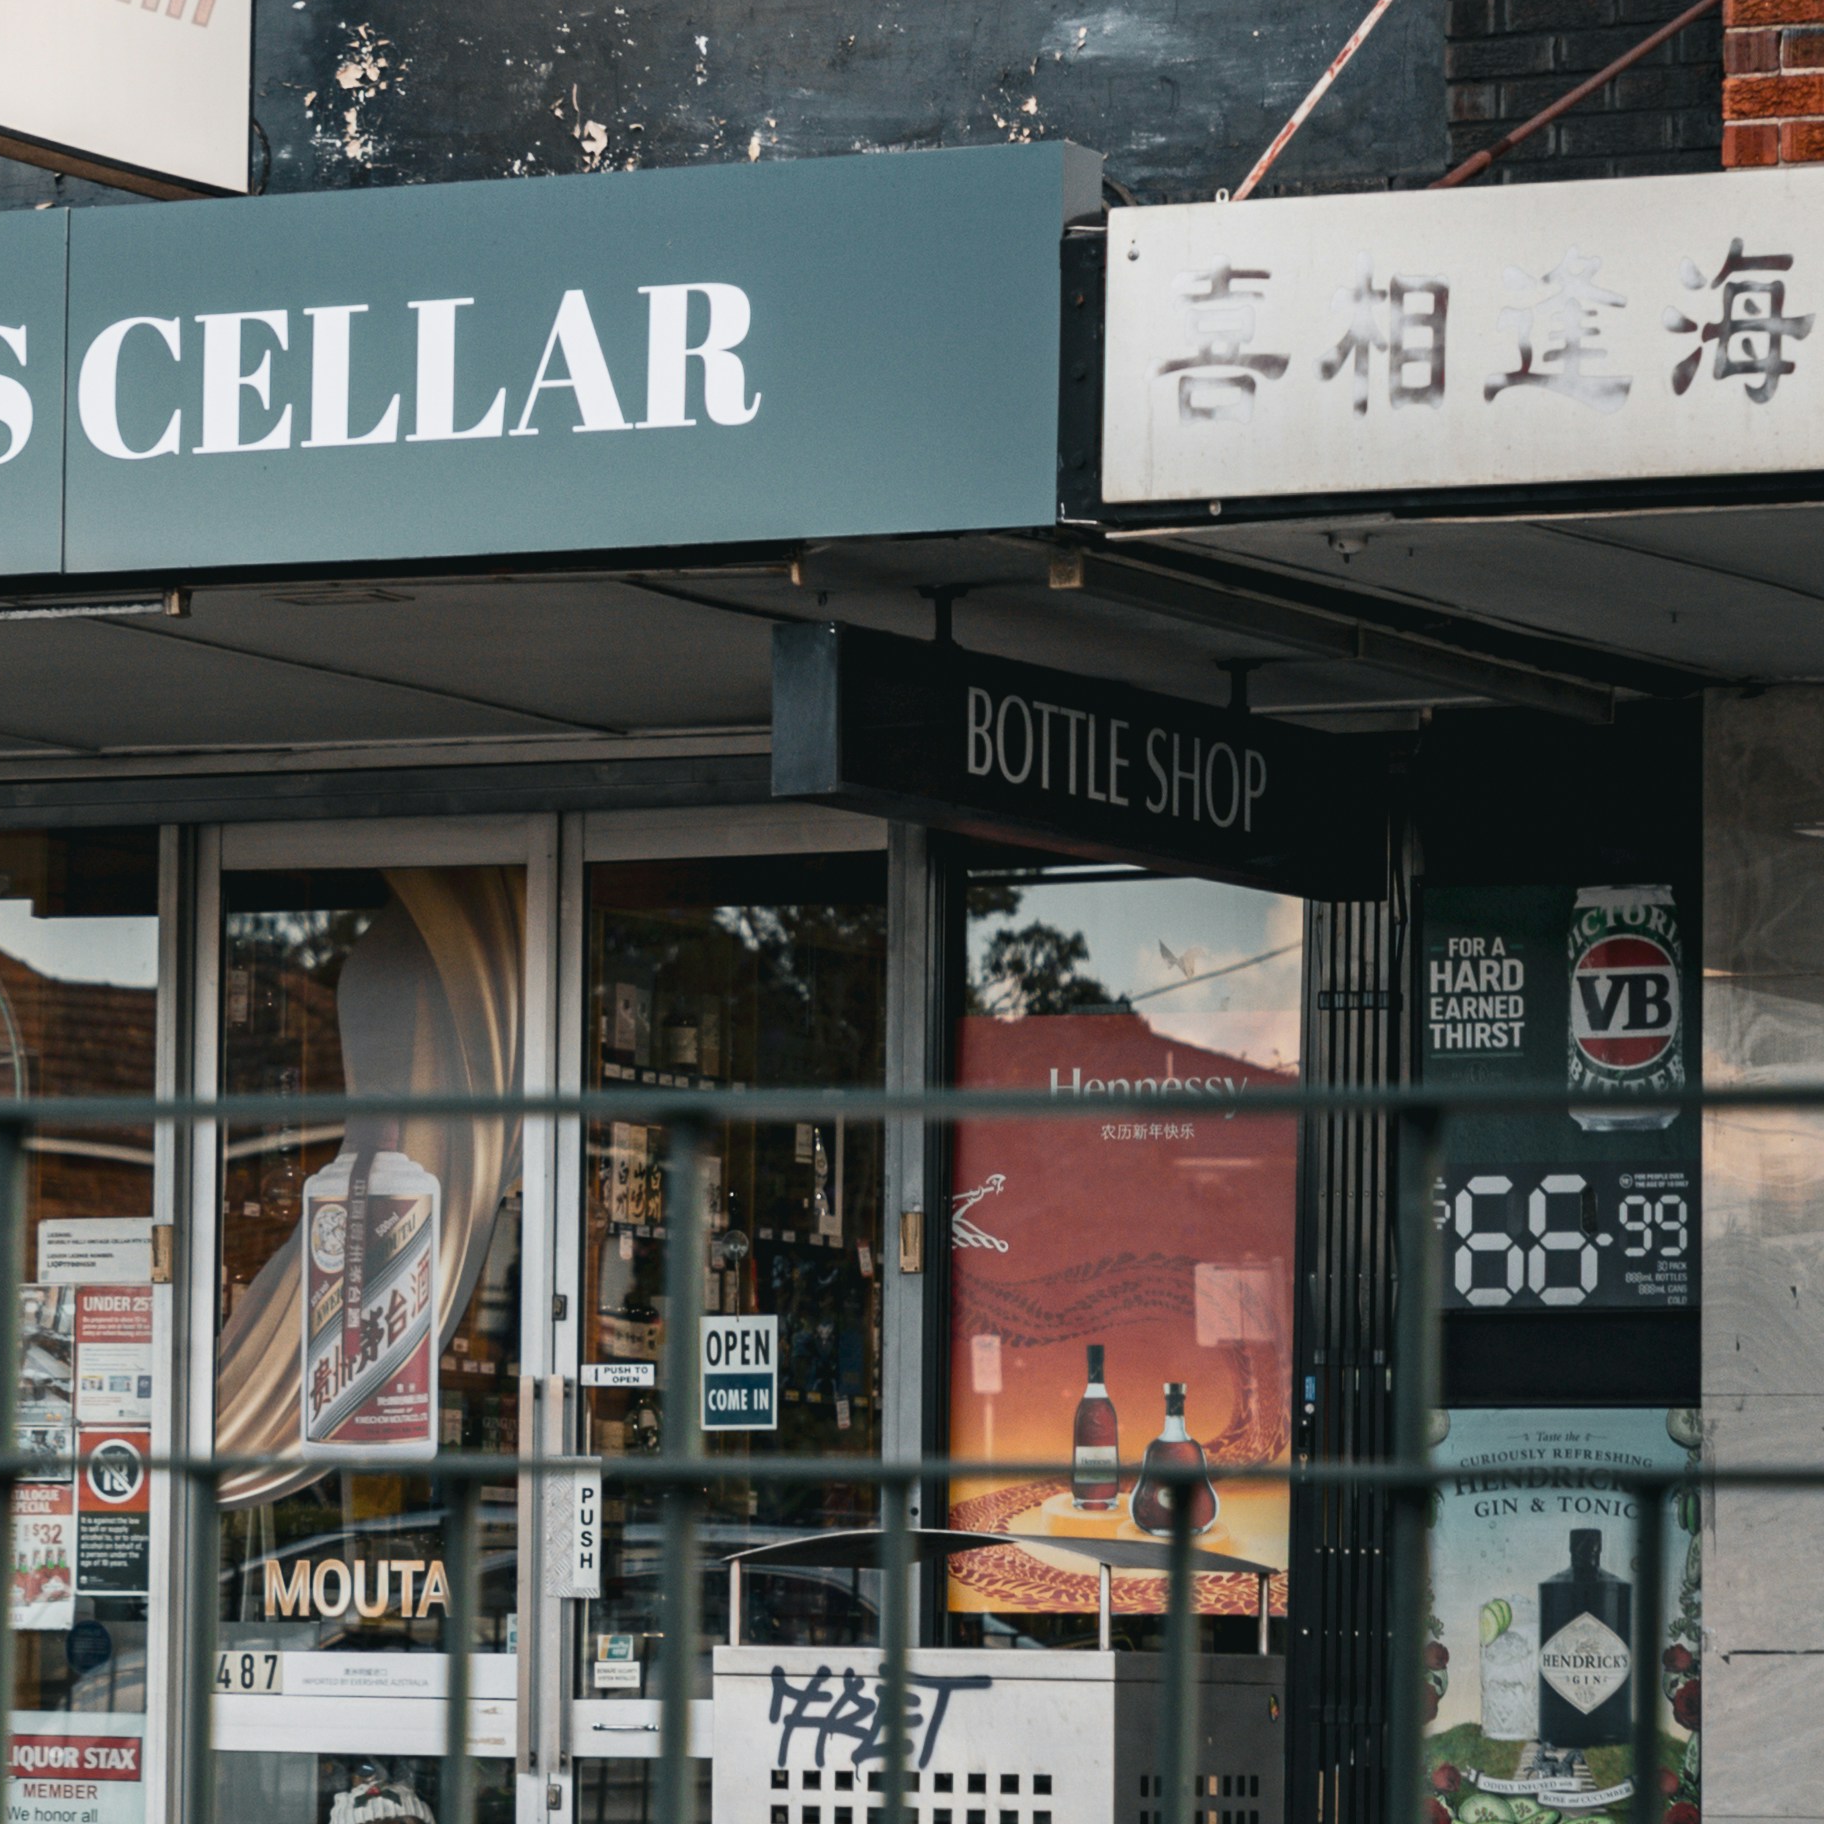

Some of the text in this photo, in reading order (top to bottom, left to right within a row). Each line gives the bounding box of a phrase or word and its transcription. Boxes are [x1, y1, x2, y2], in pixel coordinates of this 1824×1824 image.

[78, 282, 762, 460] CELLAR
[967, 686, 1267, 832] BOTTLE SHOP
[1449, 936, 1507, 958] FOR A
[1430, 958, 1525, 994] HARD
[1430, 994, 1525, 1021] EARNED
[1577, 973, 1673, 1032] VB
[1429, 1021, 1526, 1050] THIRST
[1049, 1067, 1248, 1120] Hennessy
[1100, 1123, 1196, 1141] 农历新年快乐
[1655, 1272, 1688, 1282] BOTTLES
[1667, 1284, 1688, 1294] CANS
[82, 1296, 130, 1312] UNDER
[1667, 1296, 1688, 1305] COLD
[706, 1329, 770, 1367] OPEN
[604, 1365, 648, 1375] PUSH TO
[612, 1375, 640, 1384] OPEN
[708, 1389, 770, 1412] COME IN
[1536, 1431, 1581, 1443] Taste the
[1460, 1448, 1654, 1469] CURIOUSLY REFRESHING
[1474, 1496, 1640, 1521] GIN & TONIC
[32, 1523, 63, 1545] $32
[579, 1487, 595, 1569] PUSH
[217, 1653, 279, 1690] 487
[1572, 1675, 1602, 1685] GIN
[83, 1747, 137, 1770] STAX
[23, 1783, 98, 1800] MEMBER
[7, 1806, 99, 1823] We honor all
